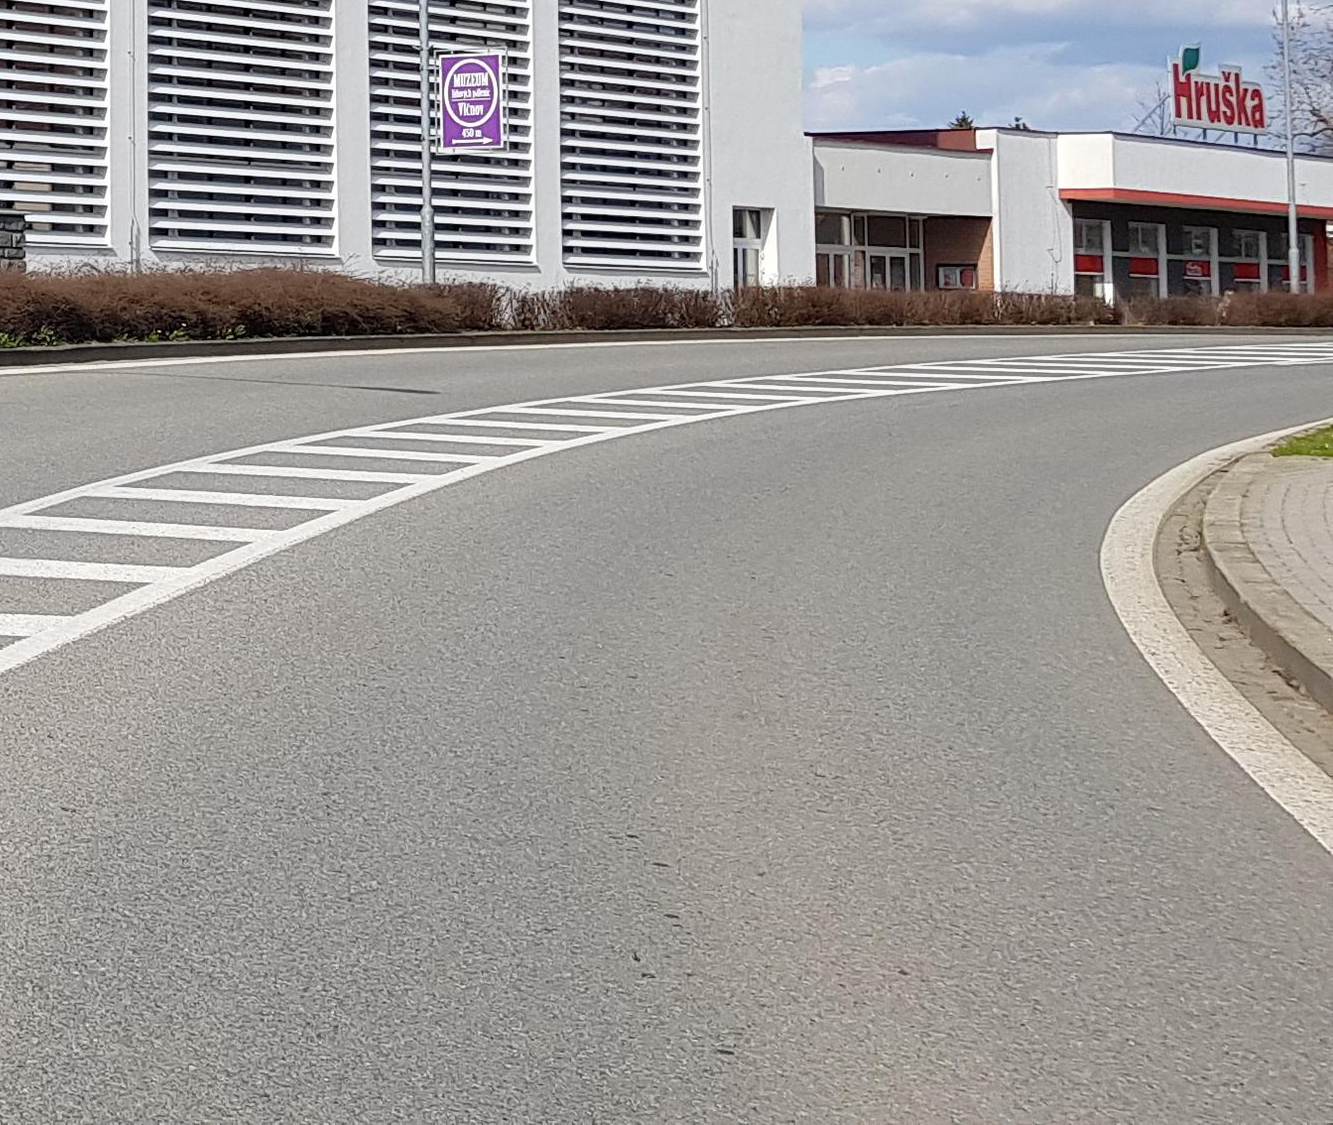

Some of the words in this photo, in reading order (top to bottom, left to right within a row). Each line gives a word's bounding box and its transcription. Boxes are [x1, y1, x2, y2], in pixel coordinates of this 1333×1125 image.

[453, 72, 488, 87] MUZEUM
[1172, 62, 1265, 129] Hruška
[458, 102, 484, 116] Vlčnov
[462, 128, 474, 138] 450
[475, 129, 482, 137] m
